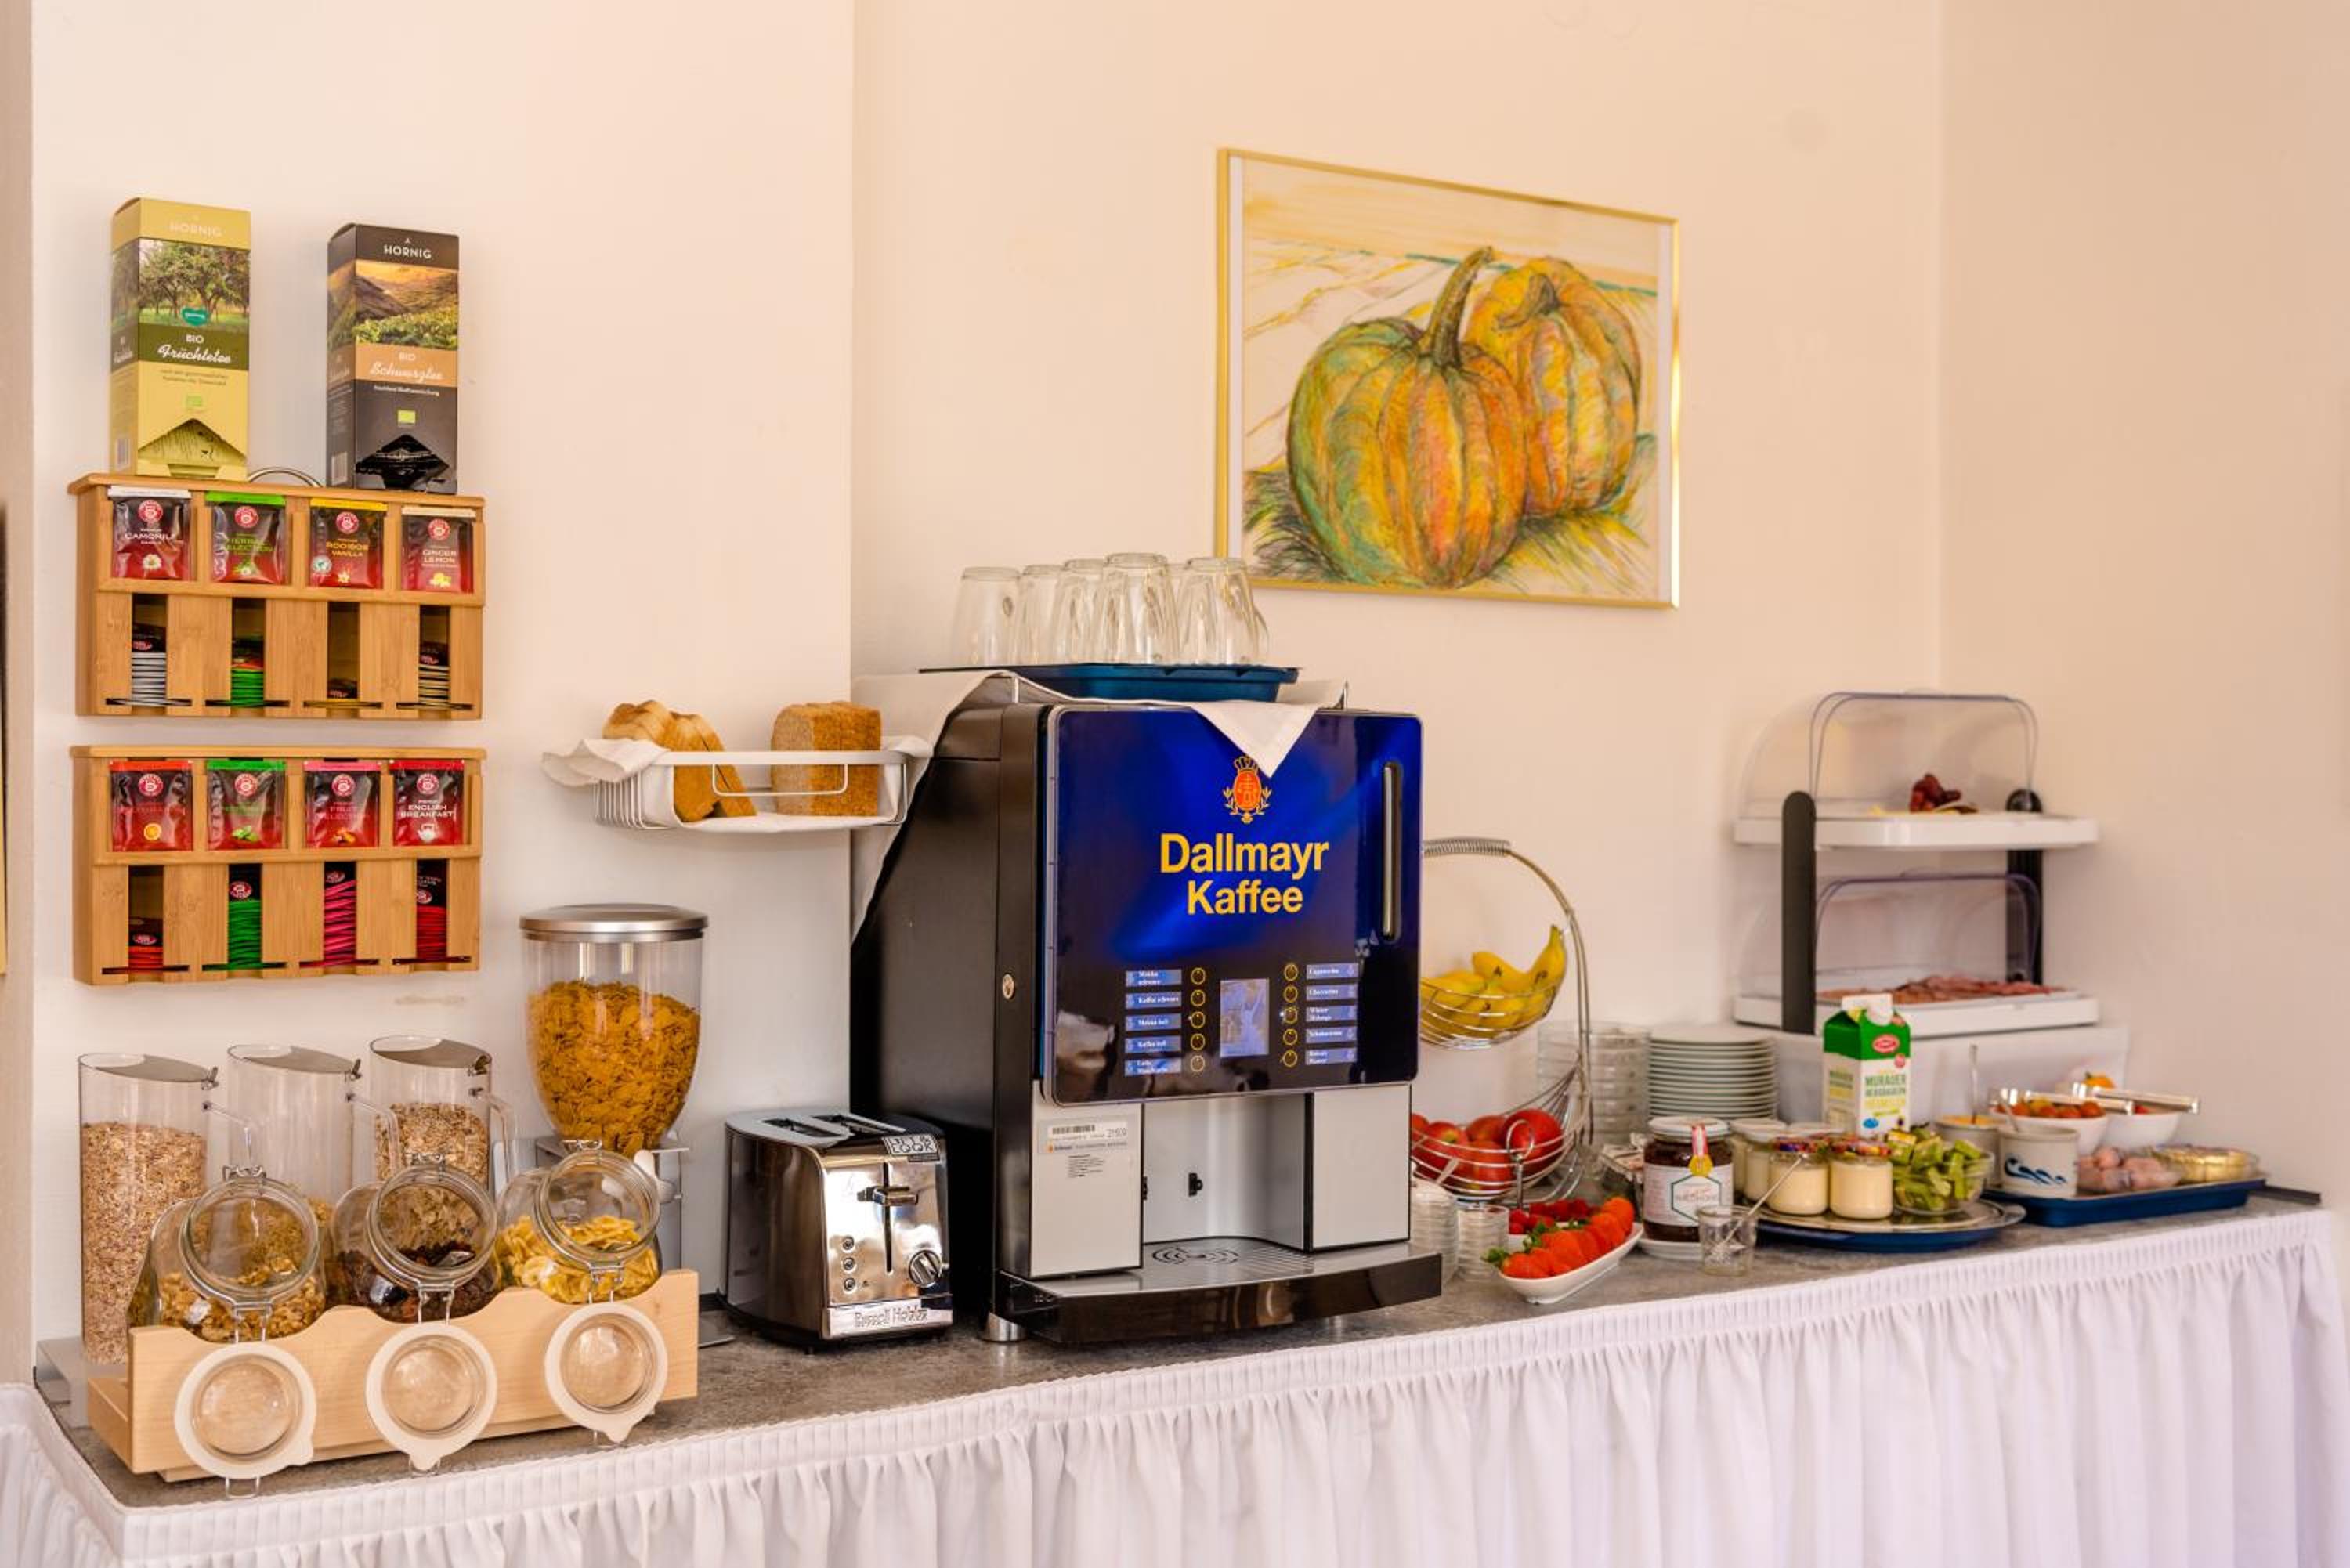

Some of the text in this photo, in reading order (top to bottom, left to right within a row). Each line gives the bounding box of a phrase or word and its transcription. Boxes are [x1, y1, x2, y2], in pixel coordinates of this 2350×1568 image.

[383, 244, 432, 260] HORNIG
[186, 334, 204, 344] BIO
[157, 343, 232, 365] Früchtetee
[399, 352, 417, 362] BIO
[369, 360, 444, 385] Schwarztee
[1160, 832, 1330, 881] Dallmayr
[1187, 879, 1304, 915] Kaffee
[1865, 1075, 1907, 1086] MURAUER
